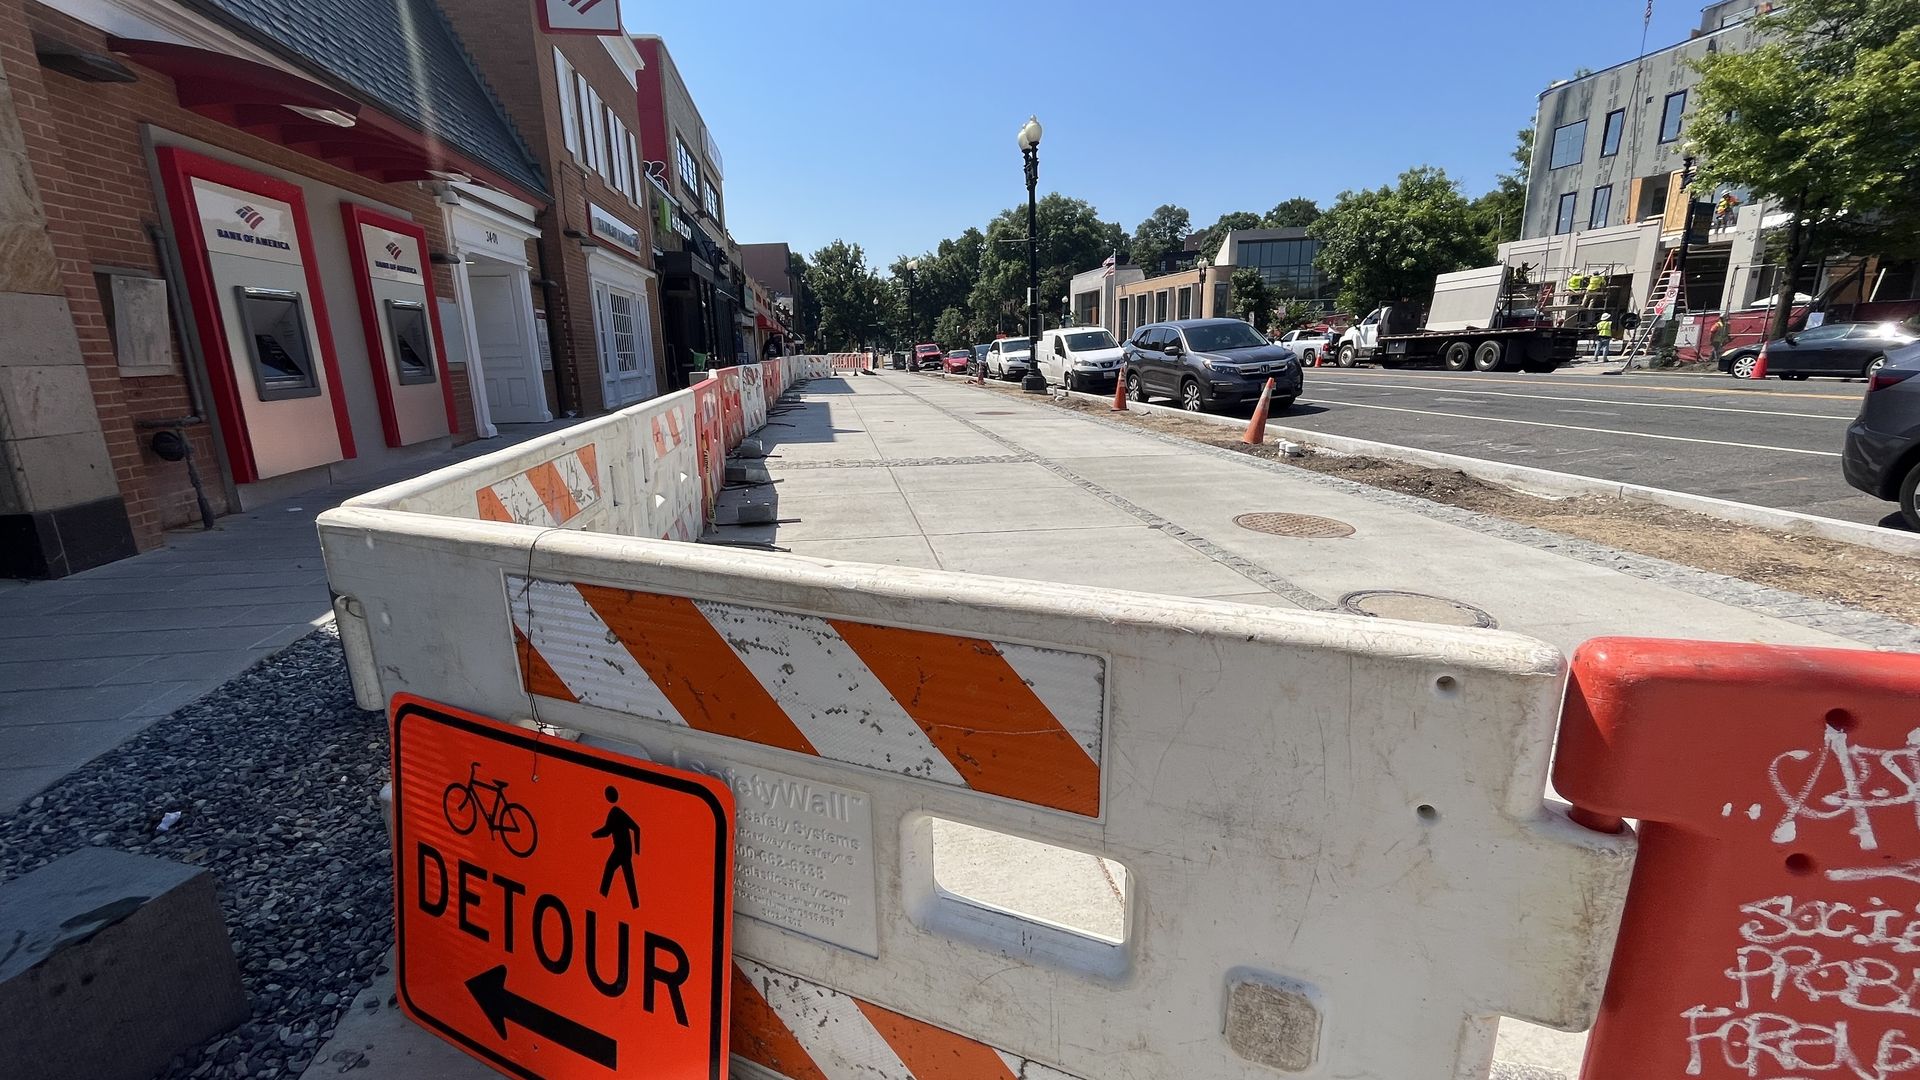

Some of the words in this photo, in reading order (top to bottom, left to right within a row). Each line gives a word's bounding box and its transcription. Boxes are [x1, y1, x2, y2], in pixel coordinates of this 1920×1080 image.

[216, 228, 242, 242] BANK
[243, 234, 254, 245] OF
[255, 237, 291, 251] AMERICA
[744, 808, 790, 834] Safety
[792, 819, 862, 851] Systems
[417, 840, 691, 1028] DETOUR
